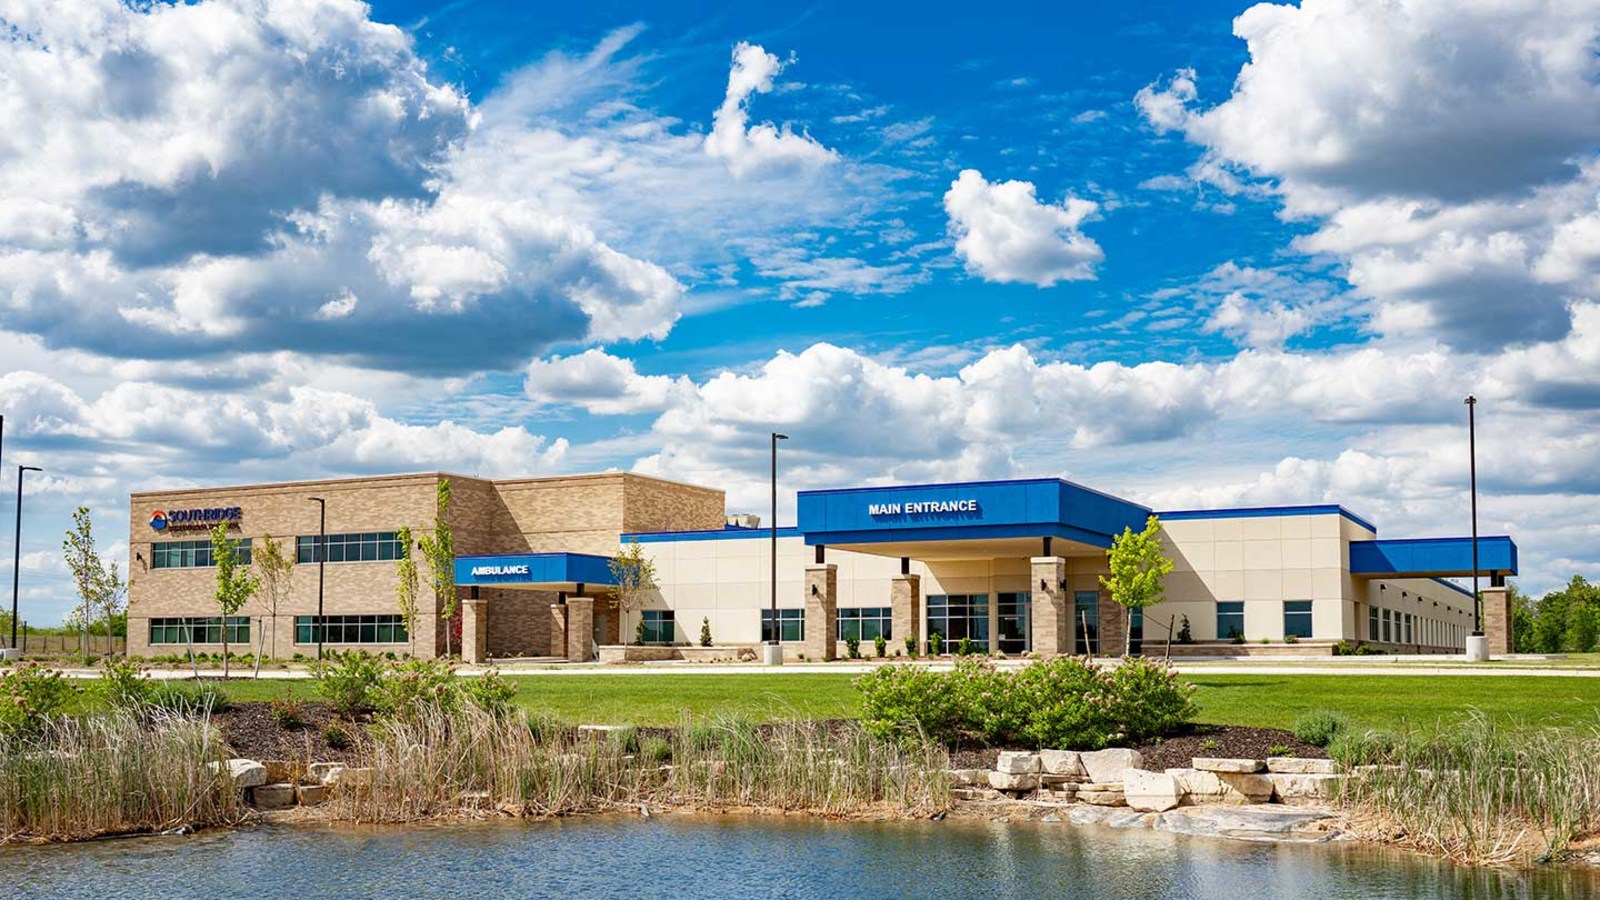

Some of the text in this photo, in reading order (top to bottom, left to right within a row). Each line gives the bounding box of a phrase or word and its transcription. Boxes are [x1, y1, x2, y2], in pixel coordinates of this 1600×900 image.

[168, 507, 242, 522] SOUTHRIDGE
[869, 500, 976, 515] MAIN ENTRANCE
[471, 565, 528, 575] AMBULANCE
